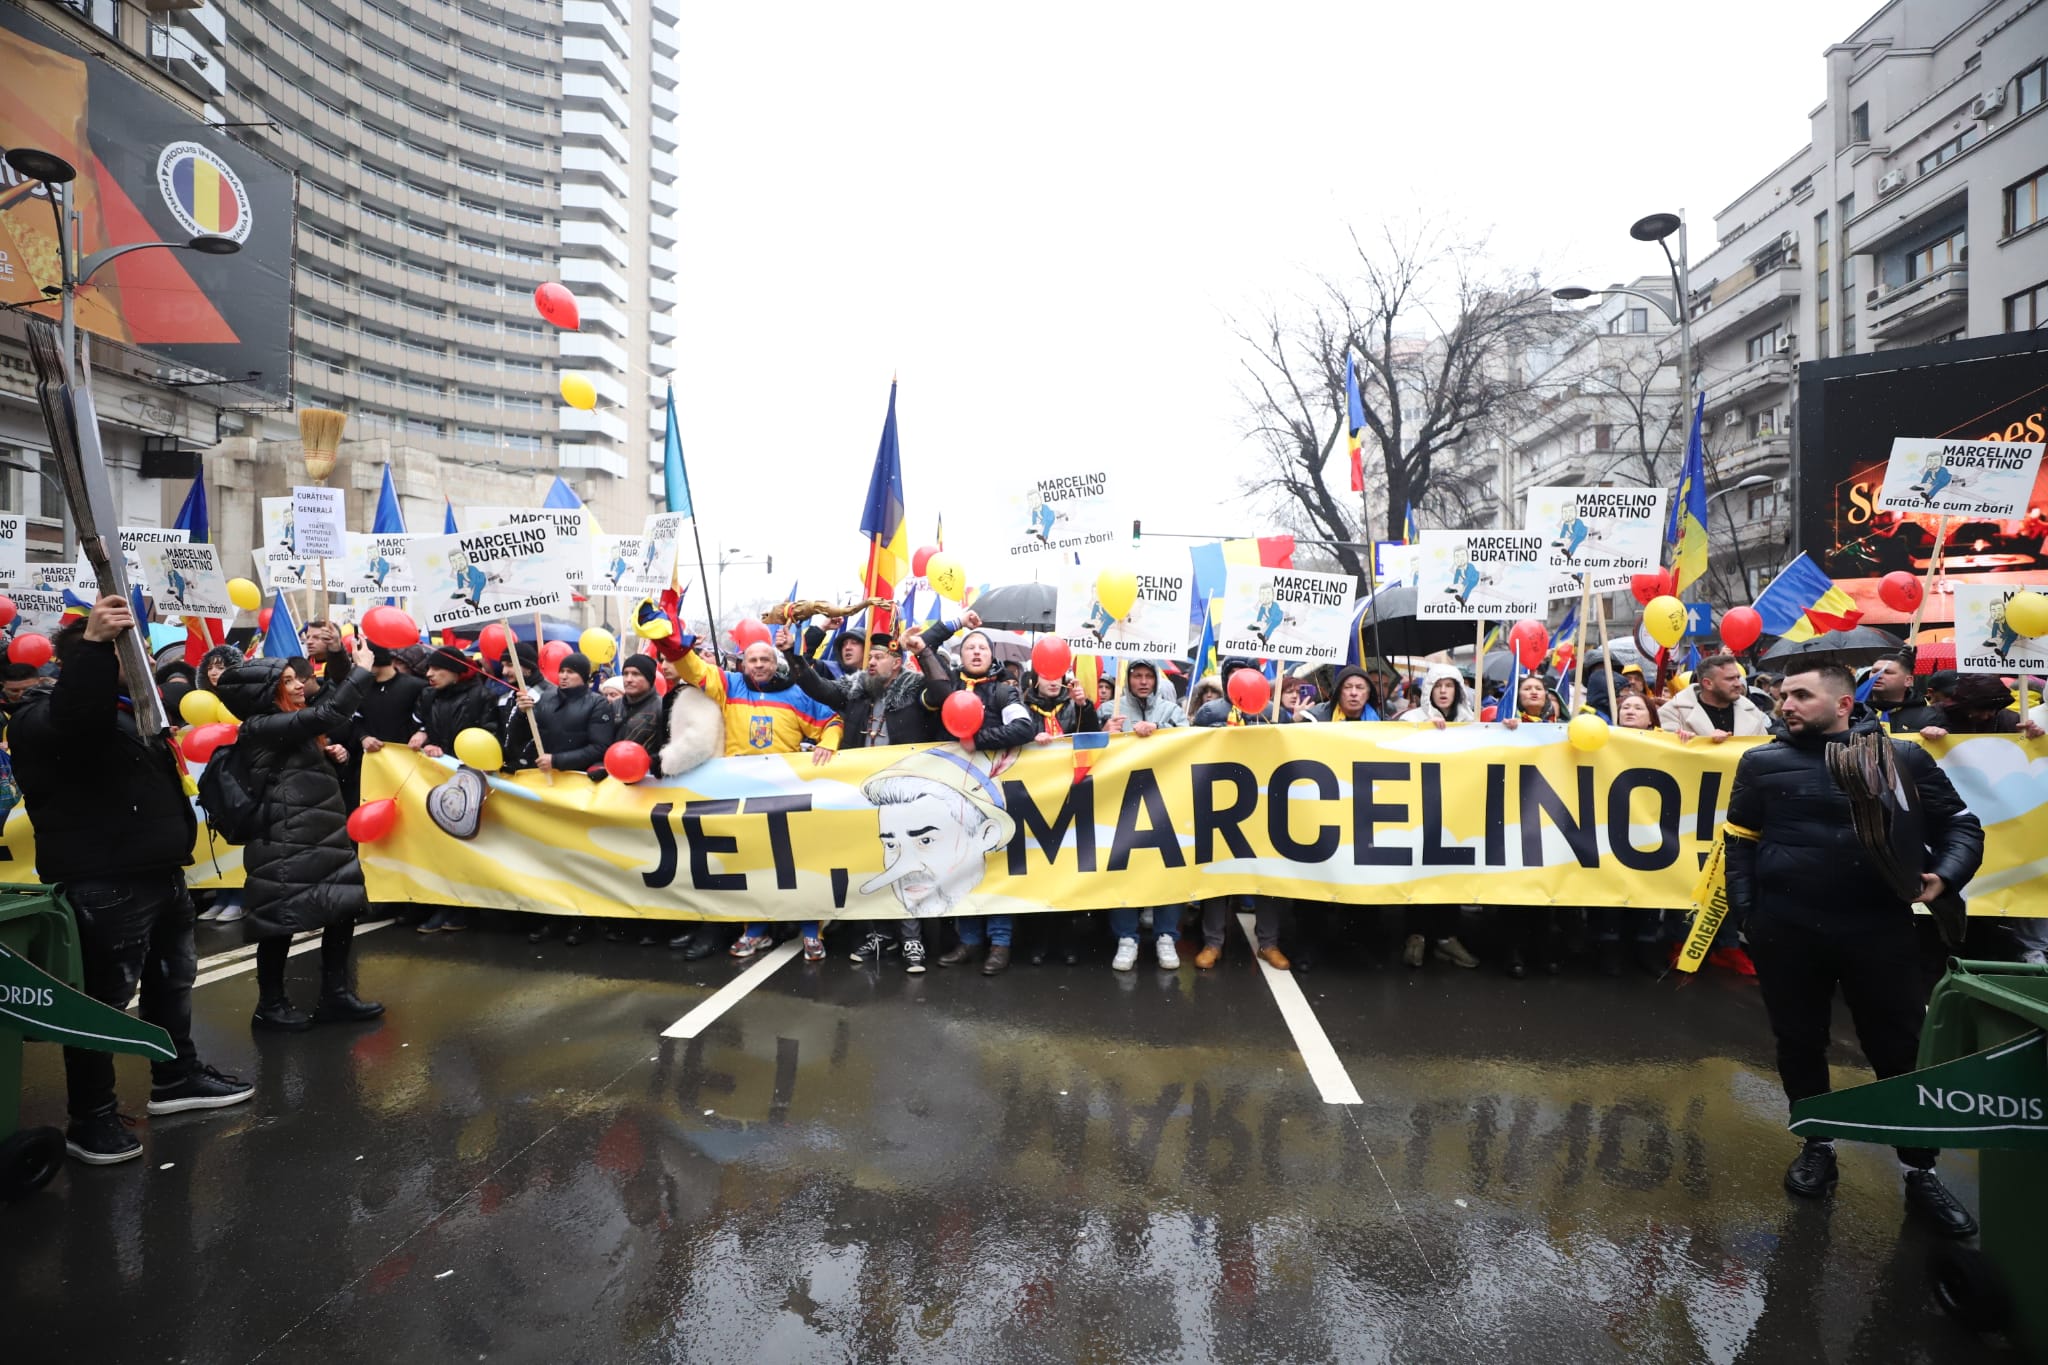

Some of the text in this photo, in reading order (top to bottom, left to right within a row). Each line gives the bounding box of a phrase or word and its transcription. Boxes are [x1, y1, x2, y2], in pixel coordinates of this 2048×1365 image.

[164, 146, 198, 169] PRODUS
[210, 156, 248, 209] ROMÂNIA
[162, 179, 197, 231] PORUMB
[1942, 445, 2032, 460] MARCELINO
[1945, 456, 2024, 470] BURATINO
[1037, 472, 1107, 492] MARCELINO
[1043, 484, 1104, 502] BURATINO
[1576, 494, 1657, 506] MARCELINO
[1579, 506, 1650, 518] BURATINO
[1886, 498, 2014, 514] arată-ne cum zbori!
[460, 528, 546, 552] MARCELINO
[1010, 532, 1114, 556] arată-ne cum zbori!
[1467, 537, 1542, 550] MARCELINO
[166, 548, 212, 560] MARCELINO
[469, 542, 544, 564] BURATINO
[1471, 550, 1538, 562] BURATINO
[172, 559, 213, 571] BURATINO
[1550, 555, 1648, 568] tă-ne cum zbori!
[328, 578, 345, 588] zbor
[566, 571, 584, 580] ori!
[1136, 576, 1183, 590] CELINO
[1273, 575, 1348, 594] MARCELINO
[1549, 581, 1584, 594] rată-n
[1594, 577, 1616, 588] cum
[1137, 590, 1178, 602] ATINO
[1276, 589, 1342, 606] BURATINO
[434, 592, 560, 624] arată-ne cum zbori!
[1424, 602, 1537, 614] arată-ne cum zbori!
[1114, 641, 1140, 650] cum
[1143, 640, 1176, 653] zbori!
[1226, 639, 1337, 658] arată-ne cum zbori!
[1964, 656, 2044, 668] arată-ne cum
[641, 793, 849, 908] JET,
[1002, 759, 1723, 875] MARCELINO!
[0, 984, 54, 1006] ORDIS
[1916, 1084, 2044, 1120] NORDIS
